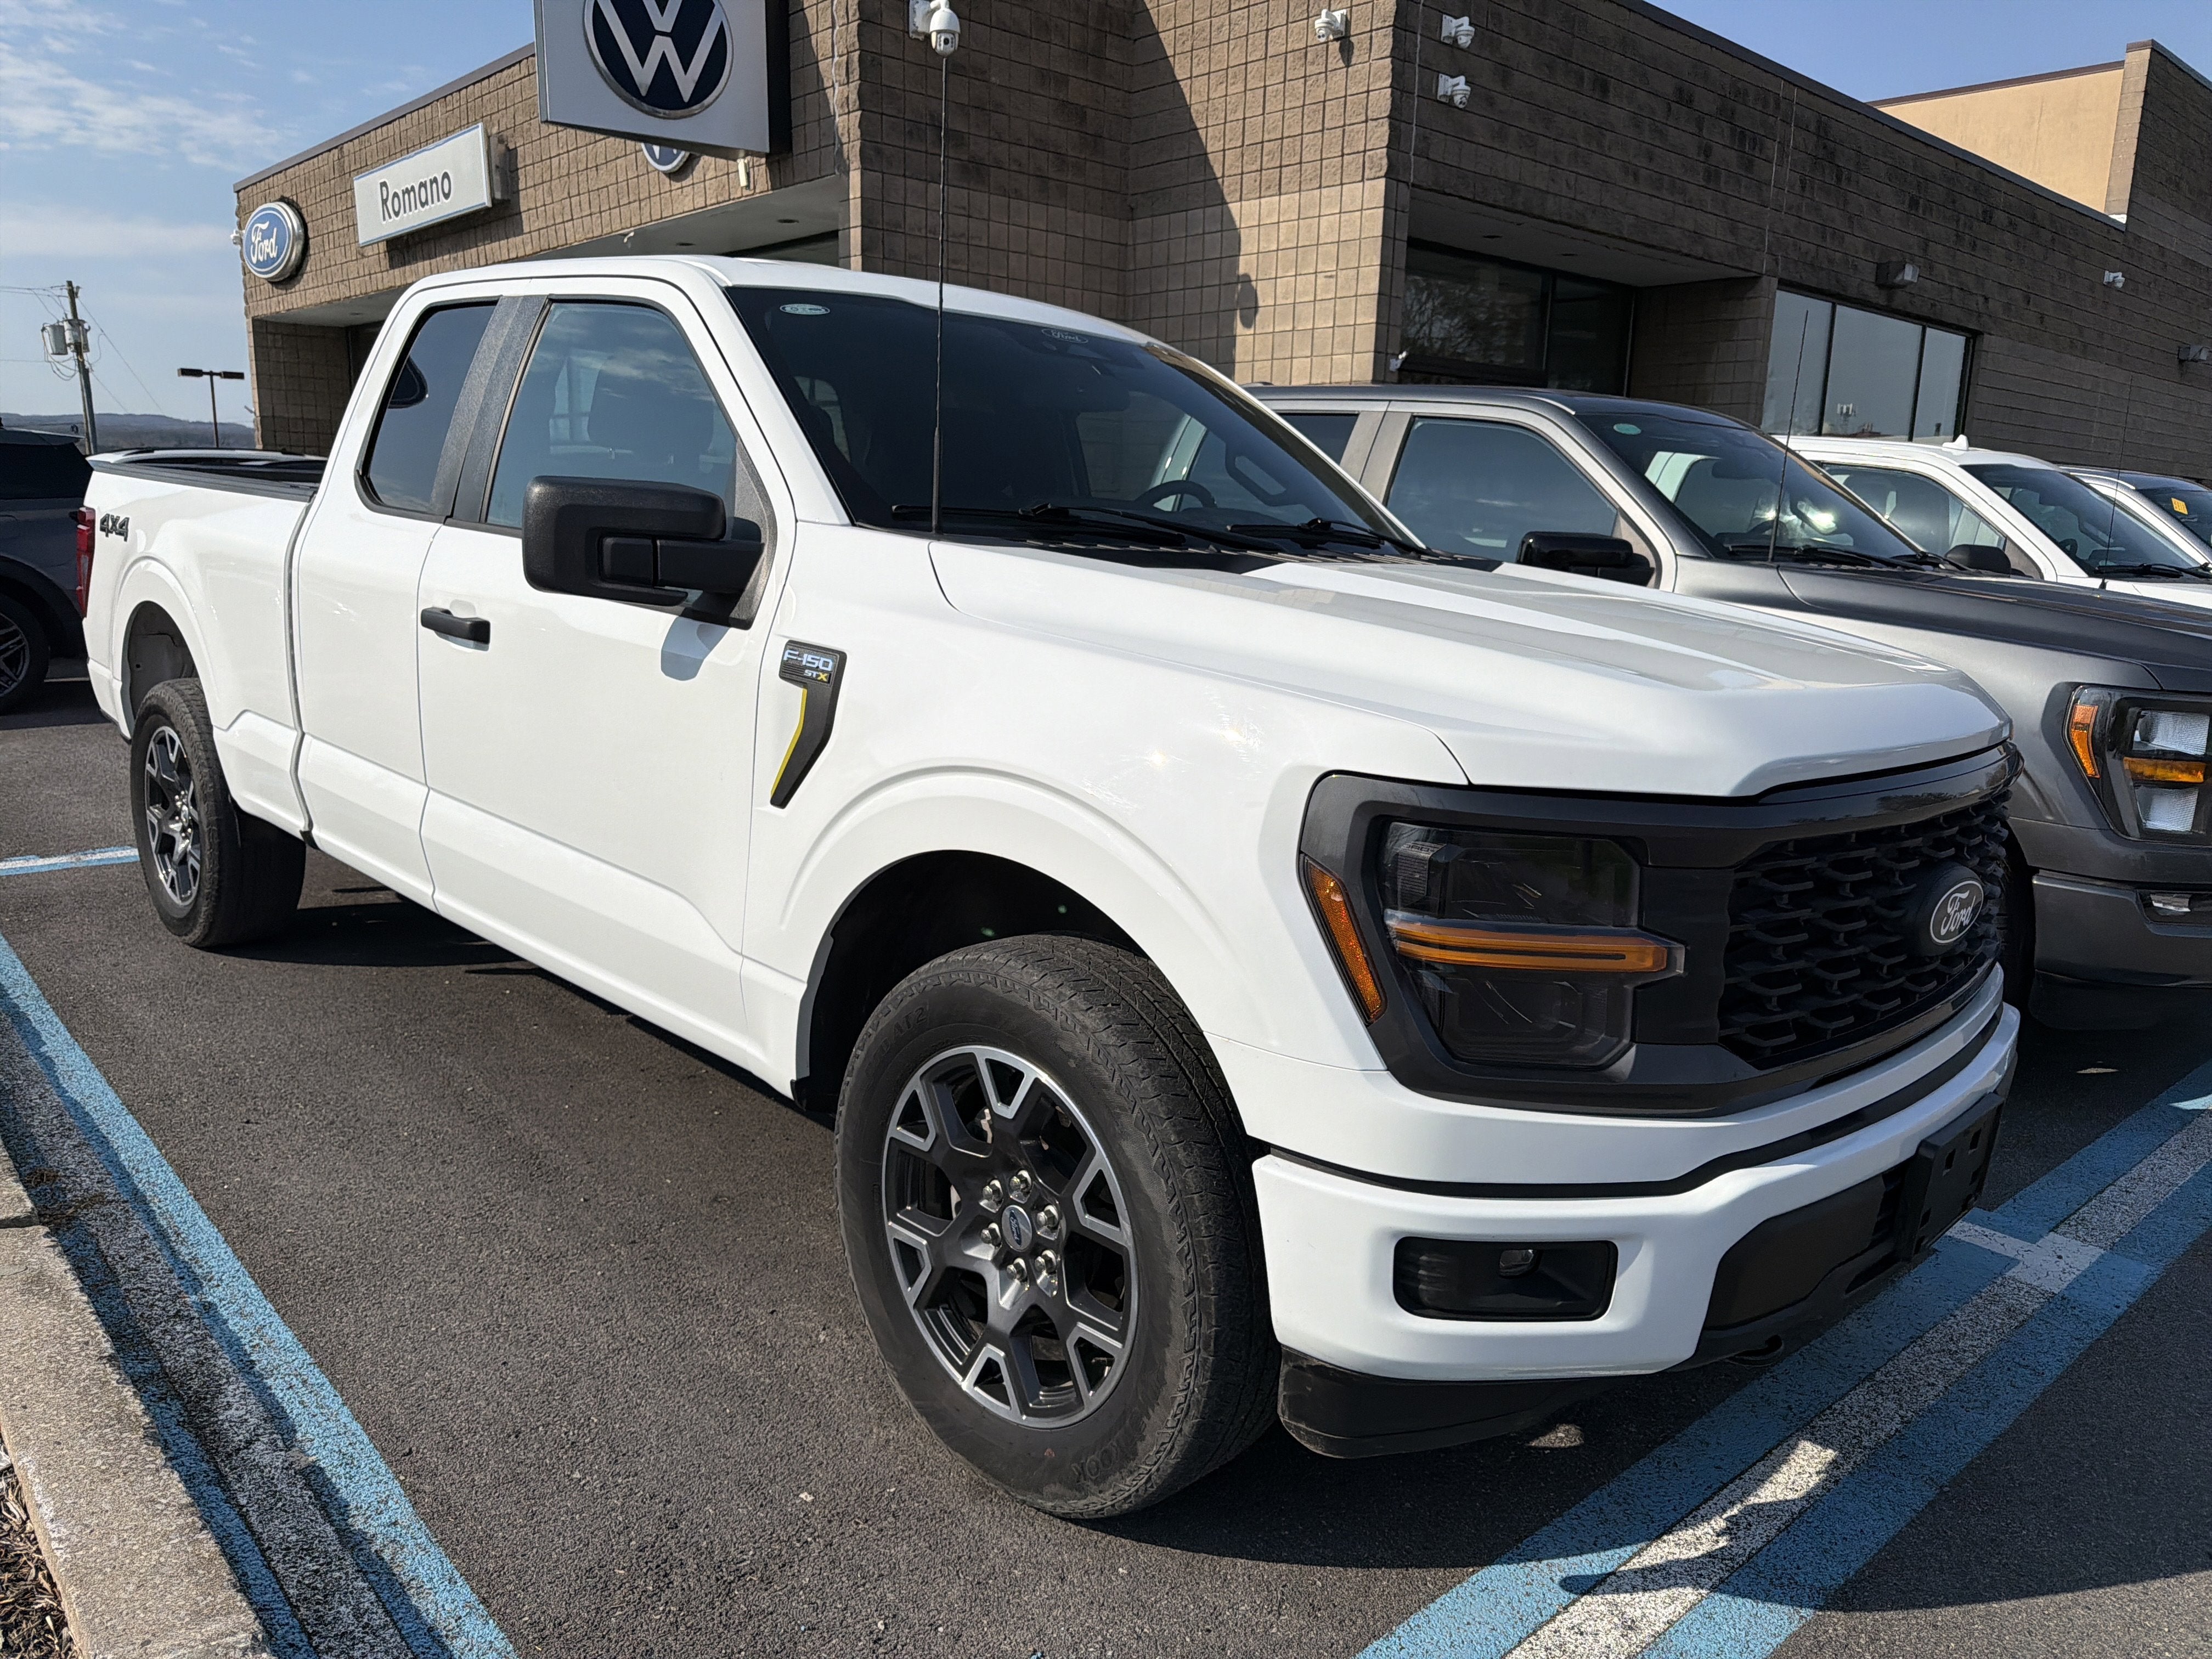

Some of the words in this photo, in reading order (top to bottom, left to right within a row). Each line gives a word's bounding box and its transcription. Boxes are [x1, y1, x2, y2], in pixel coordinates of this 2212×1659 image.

[379, 171, 452, 222] Romano
[250, 221, 278, 264] Ford
[783, 649, 833, 672] F-150
[803, 669, 828, 682] STX
[1940, 889, 1976, 936] Ford
